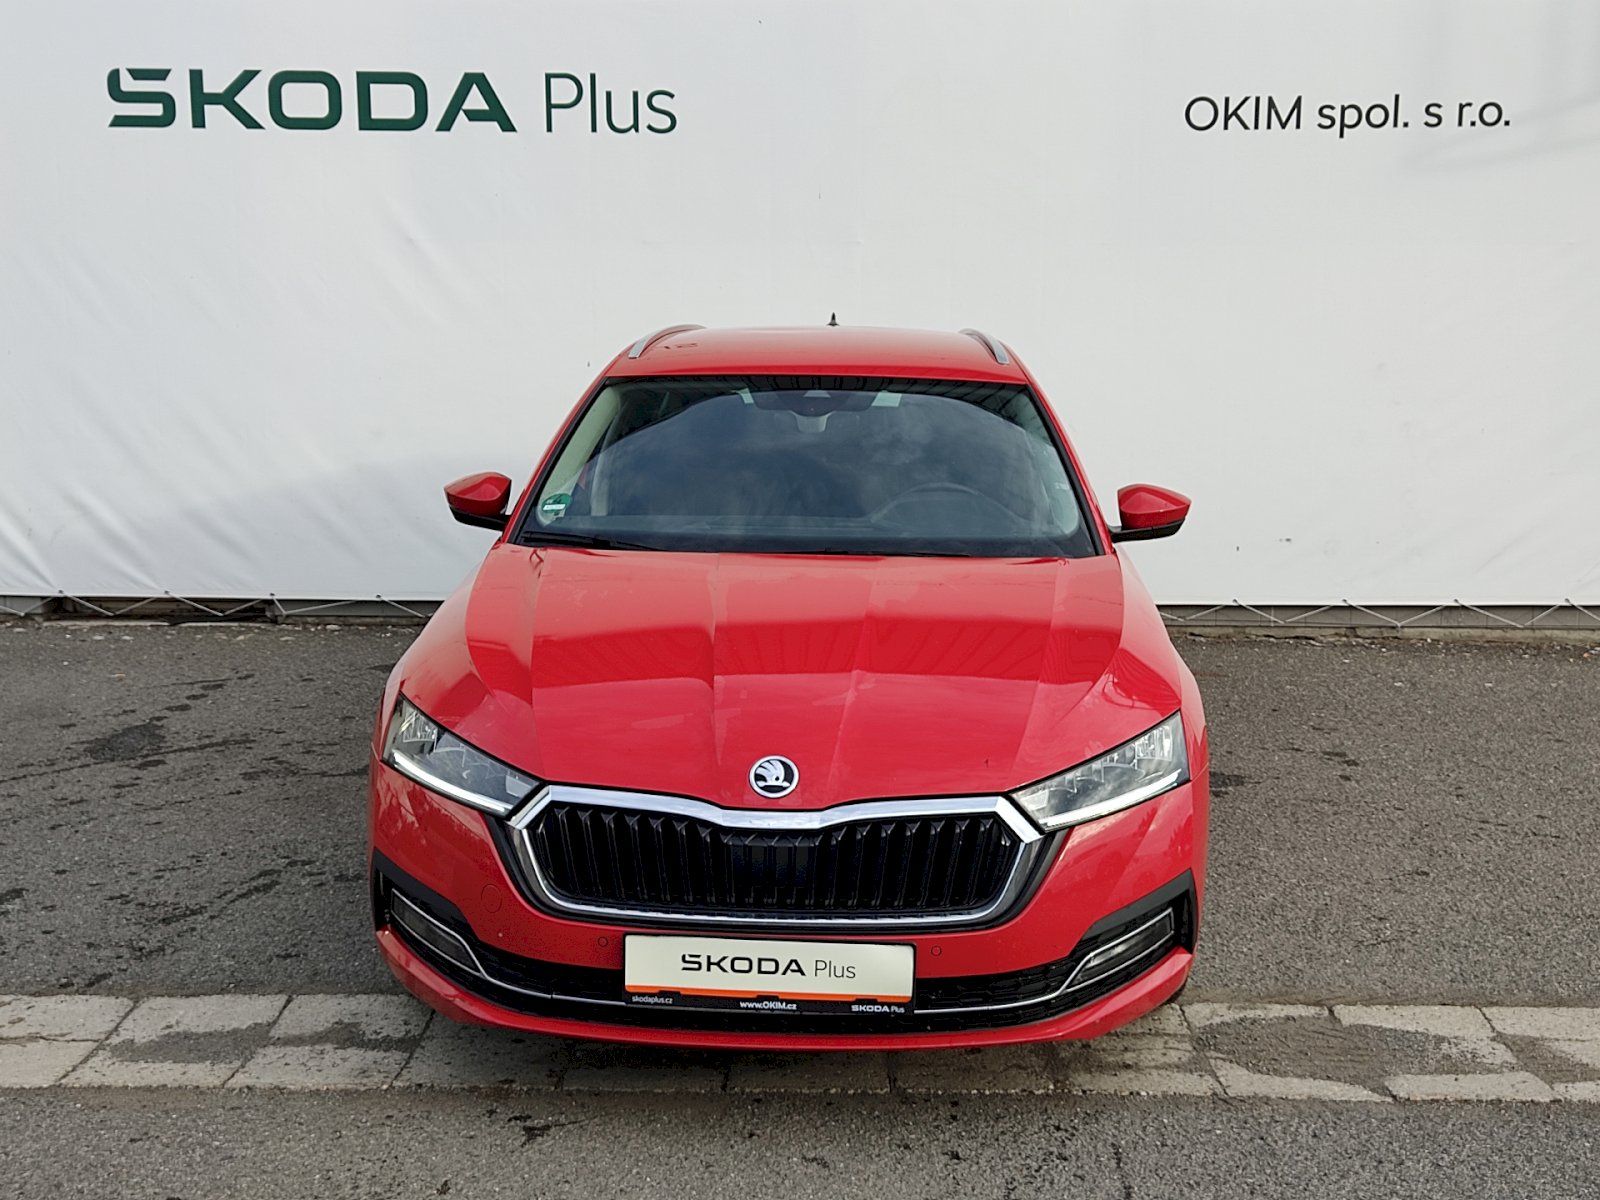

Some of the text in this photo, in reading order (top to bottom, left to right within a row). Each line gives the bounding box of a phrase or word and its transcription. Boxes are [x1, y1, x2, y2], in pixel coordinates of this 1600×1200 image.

[544, 73, 678, 135] Plus
[1185, 93, 1511, 139] OKIM spol. s r.o.
[814, 959, 857, 979] Plus
[739, 1000, 797, 1010] www.OKIM.cz
[891, 1006, 905, 1014] Plus
